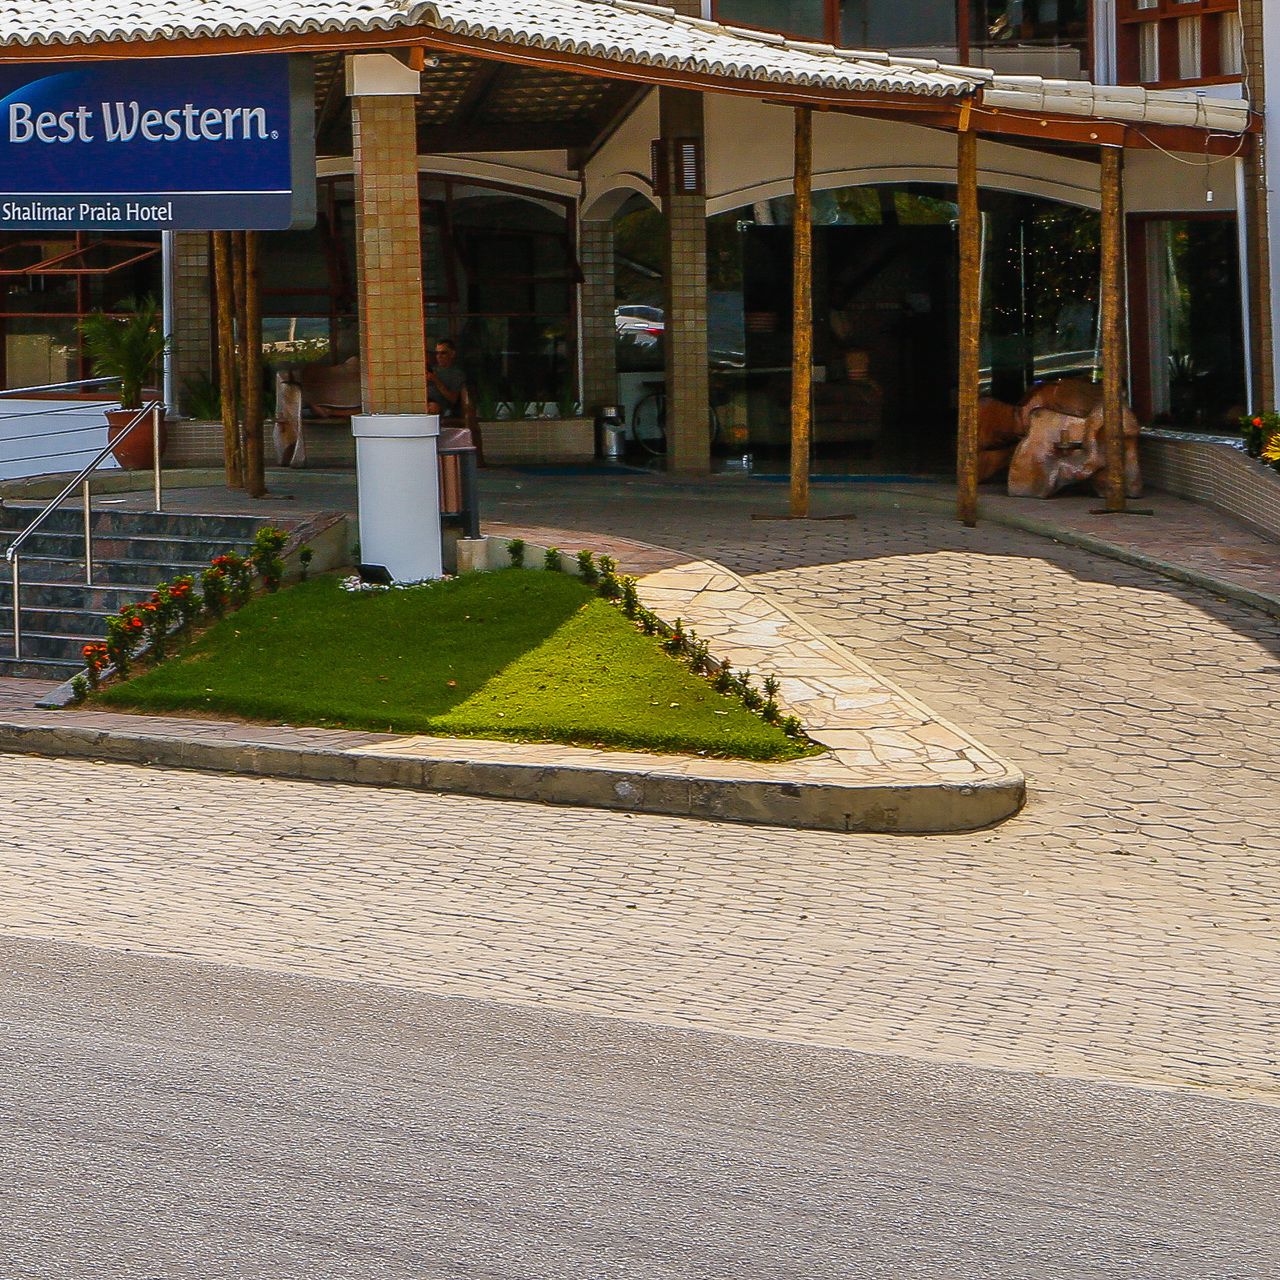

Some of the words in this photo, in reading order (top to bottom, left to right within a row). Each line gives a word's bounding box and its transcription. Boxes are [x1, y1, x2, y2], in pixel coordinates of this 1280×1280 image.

[9, 102, 95, 143] Best
[101, 101, 269, 142] Western
[2, 202, 75, 221] Shalimar
[79, 202, 122, 221] Praia
[126, 201, 173, 221] Hotel
